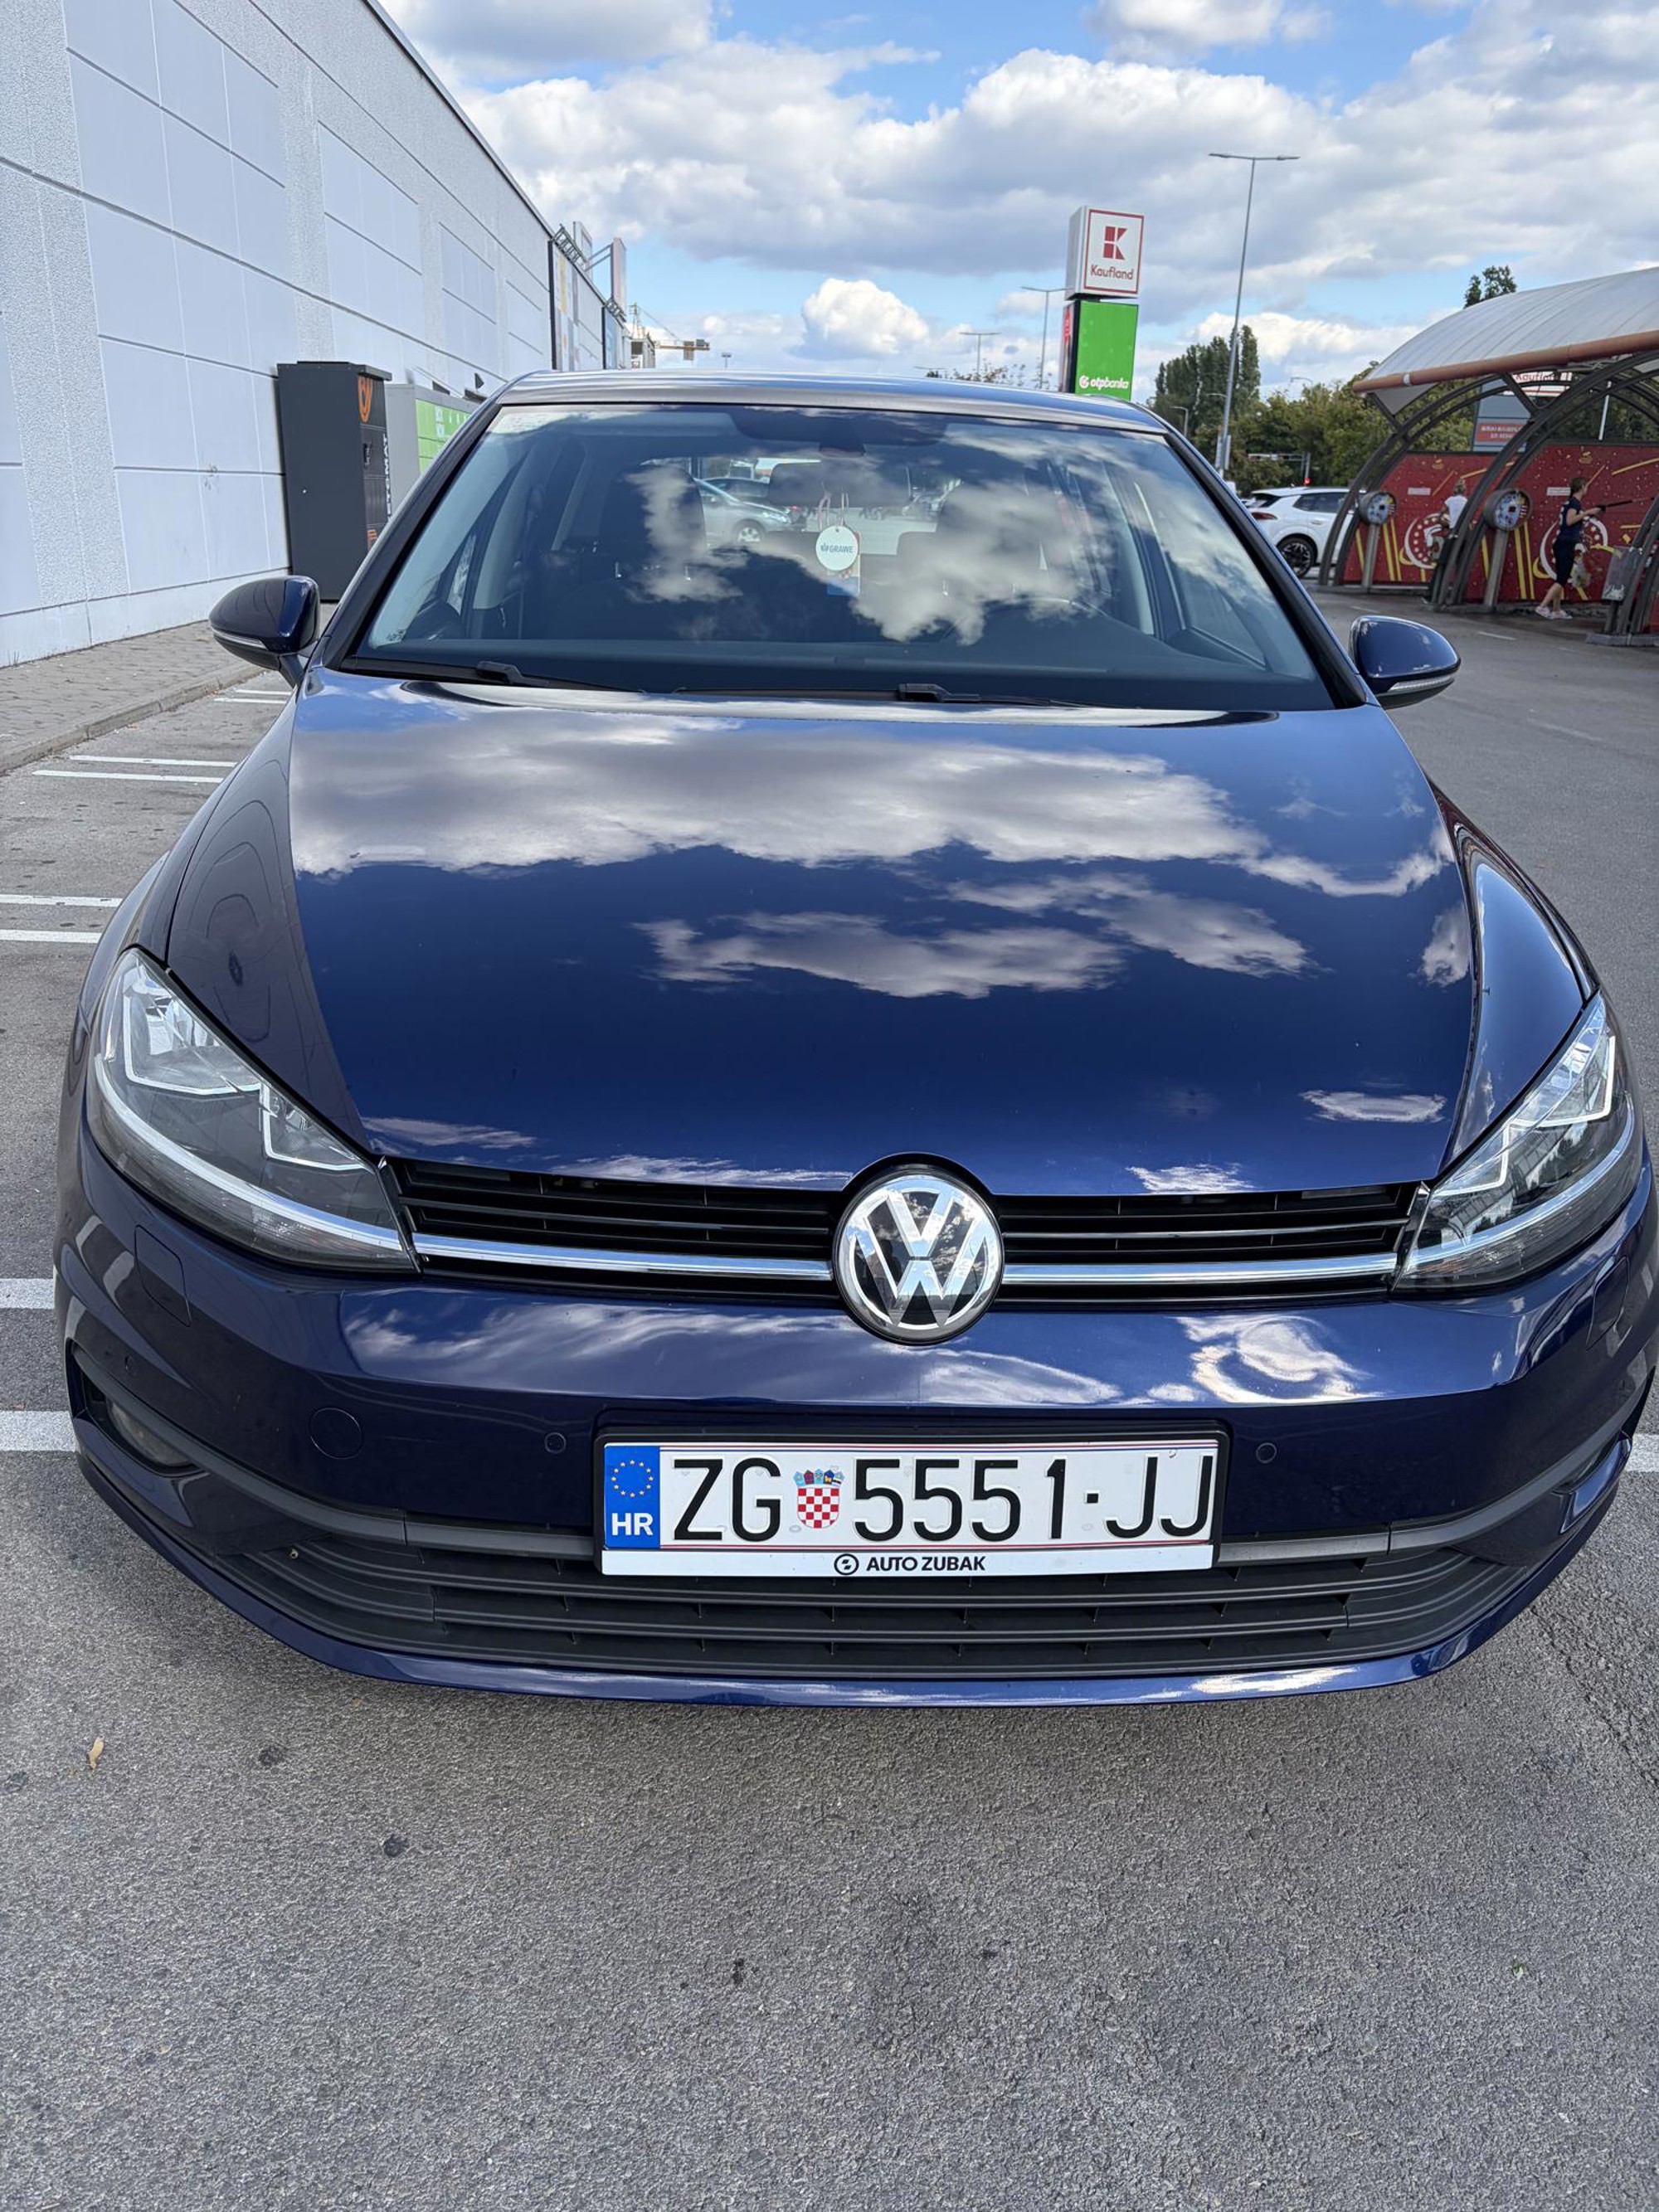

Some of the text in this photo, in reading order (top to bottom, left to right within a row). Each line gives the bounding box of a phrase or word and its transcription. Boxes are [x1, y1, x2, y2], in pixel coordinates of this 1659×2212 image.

[1090, 265, 1134, 280] Kaufland
[674, 1457, 781, 1542] ZG
[611, 1512, 654, 1536] HR
[866, 1556, 985, 1572] AUTO ZUBAK
